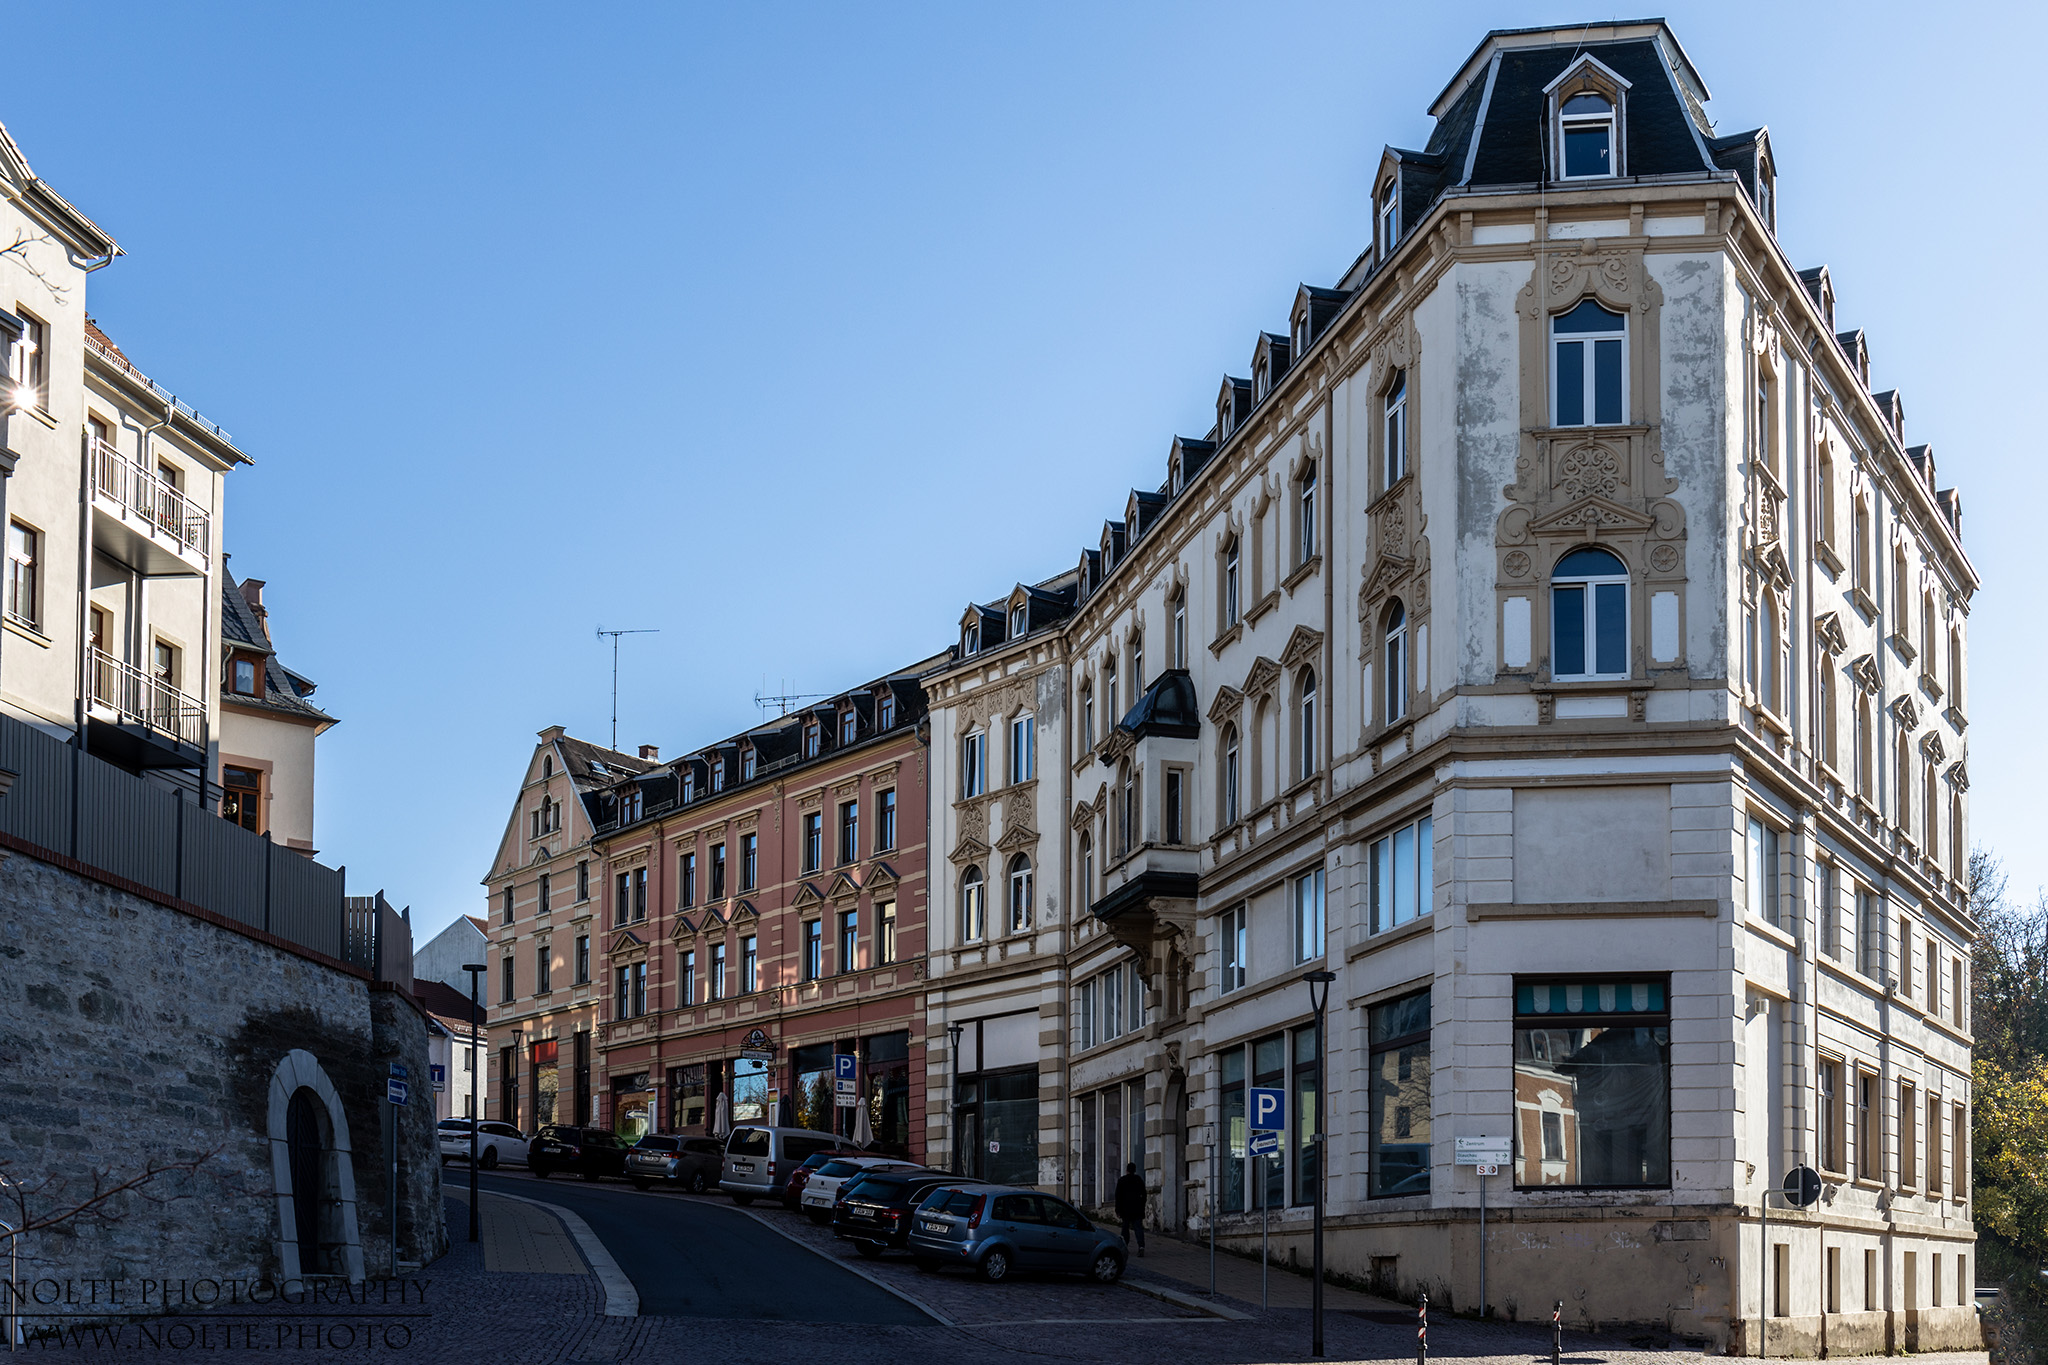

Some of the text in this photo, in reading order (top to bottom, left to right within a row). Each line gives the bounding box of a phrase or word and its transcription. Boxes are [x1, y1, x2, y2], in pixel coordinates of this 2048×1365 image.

[840, 1058, 852, 1076] P
[1258, 1094, 1277, 1125] P
[1479, 1166, 1486, 1174] S
